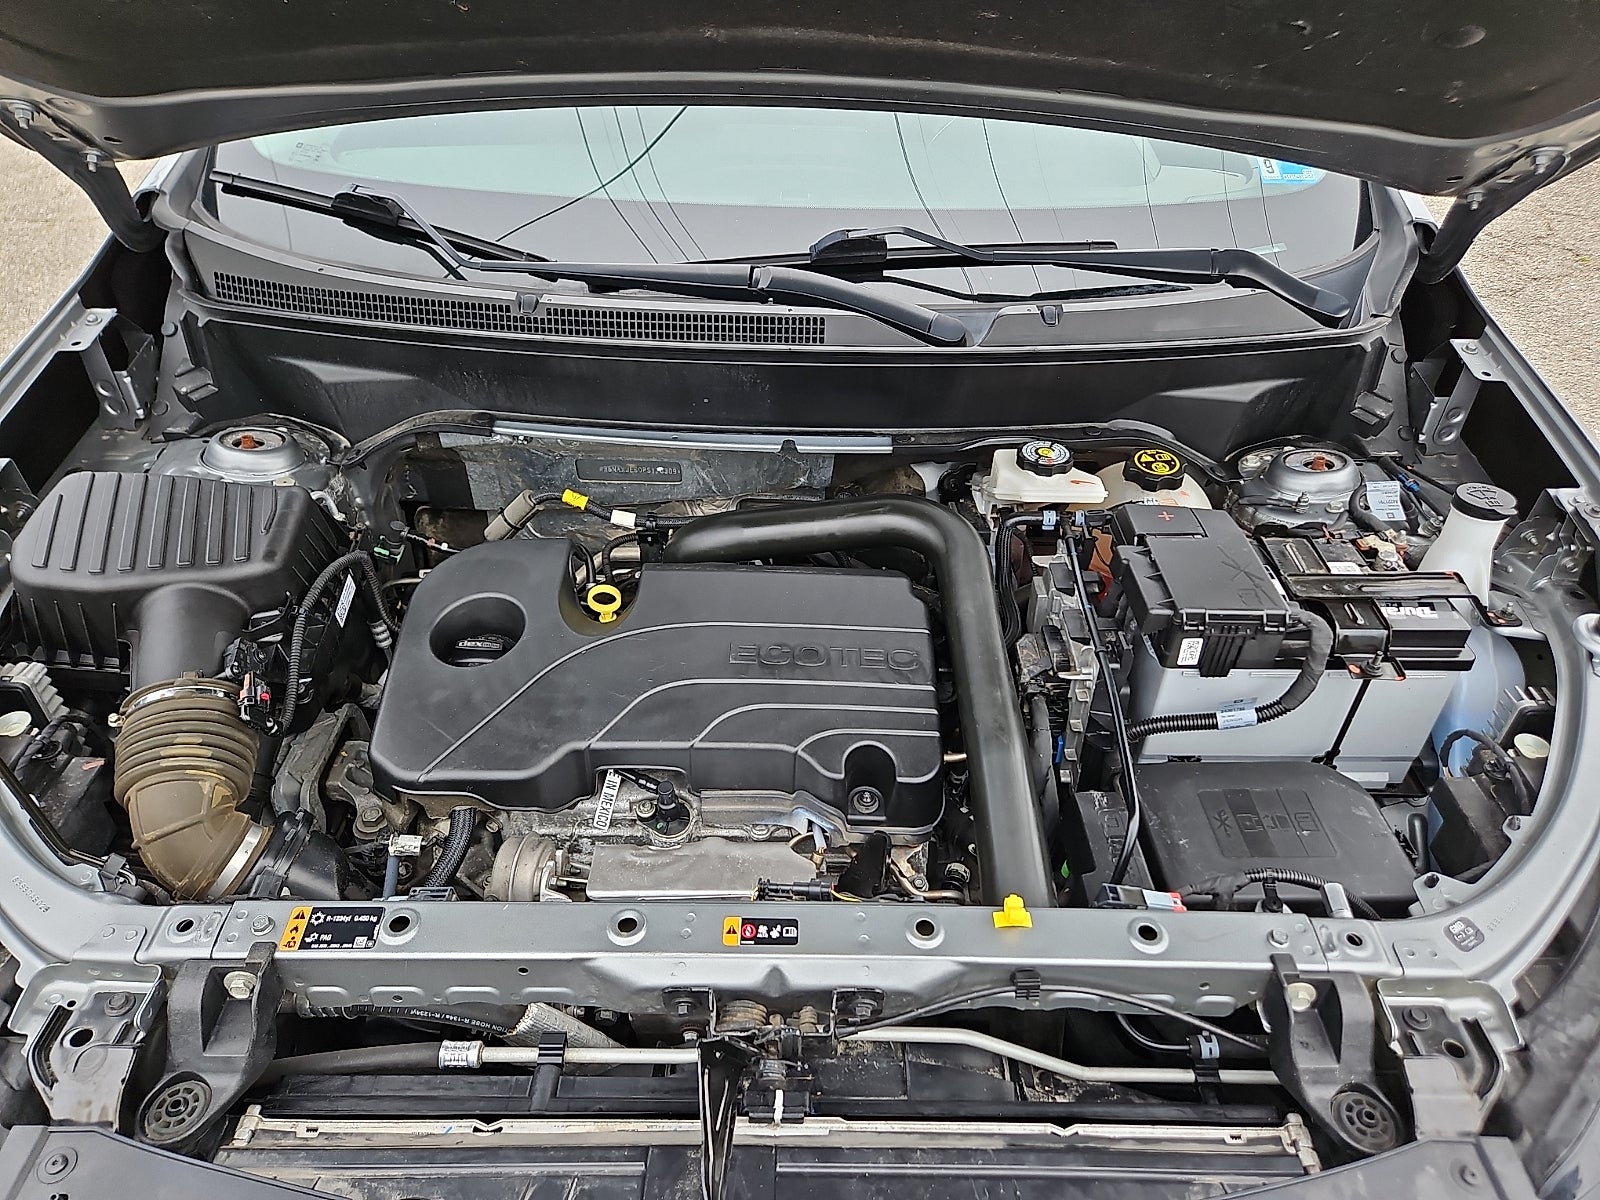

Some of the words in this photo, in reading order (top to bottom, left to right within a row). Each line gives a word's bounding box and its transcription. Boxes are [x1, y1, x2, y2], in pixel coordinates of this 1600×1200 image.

[729, 643, 919, 670] ECOTEC
[606, 780, 617, 790] IN
[596, 792, 615, 827] MEXICO
[471, 1019, 491, 1030] HOSE
